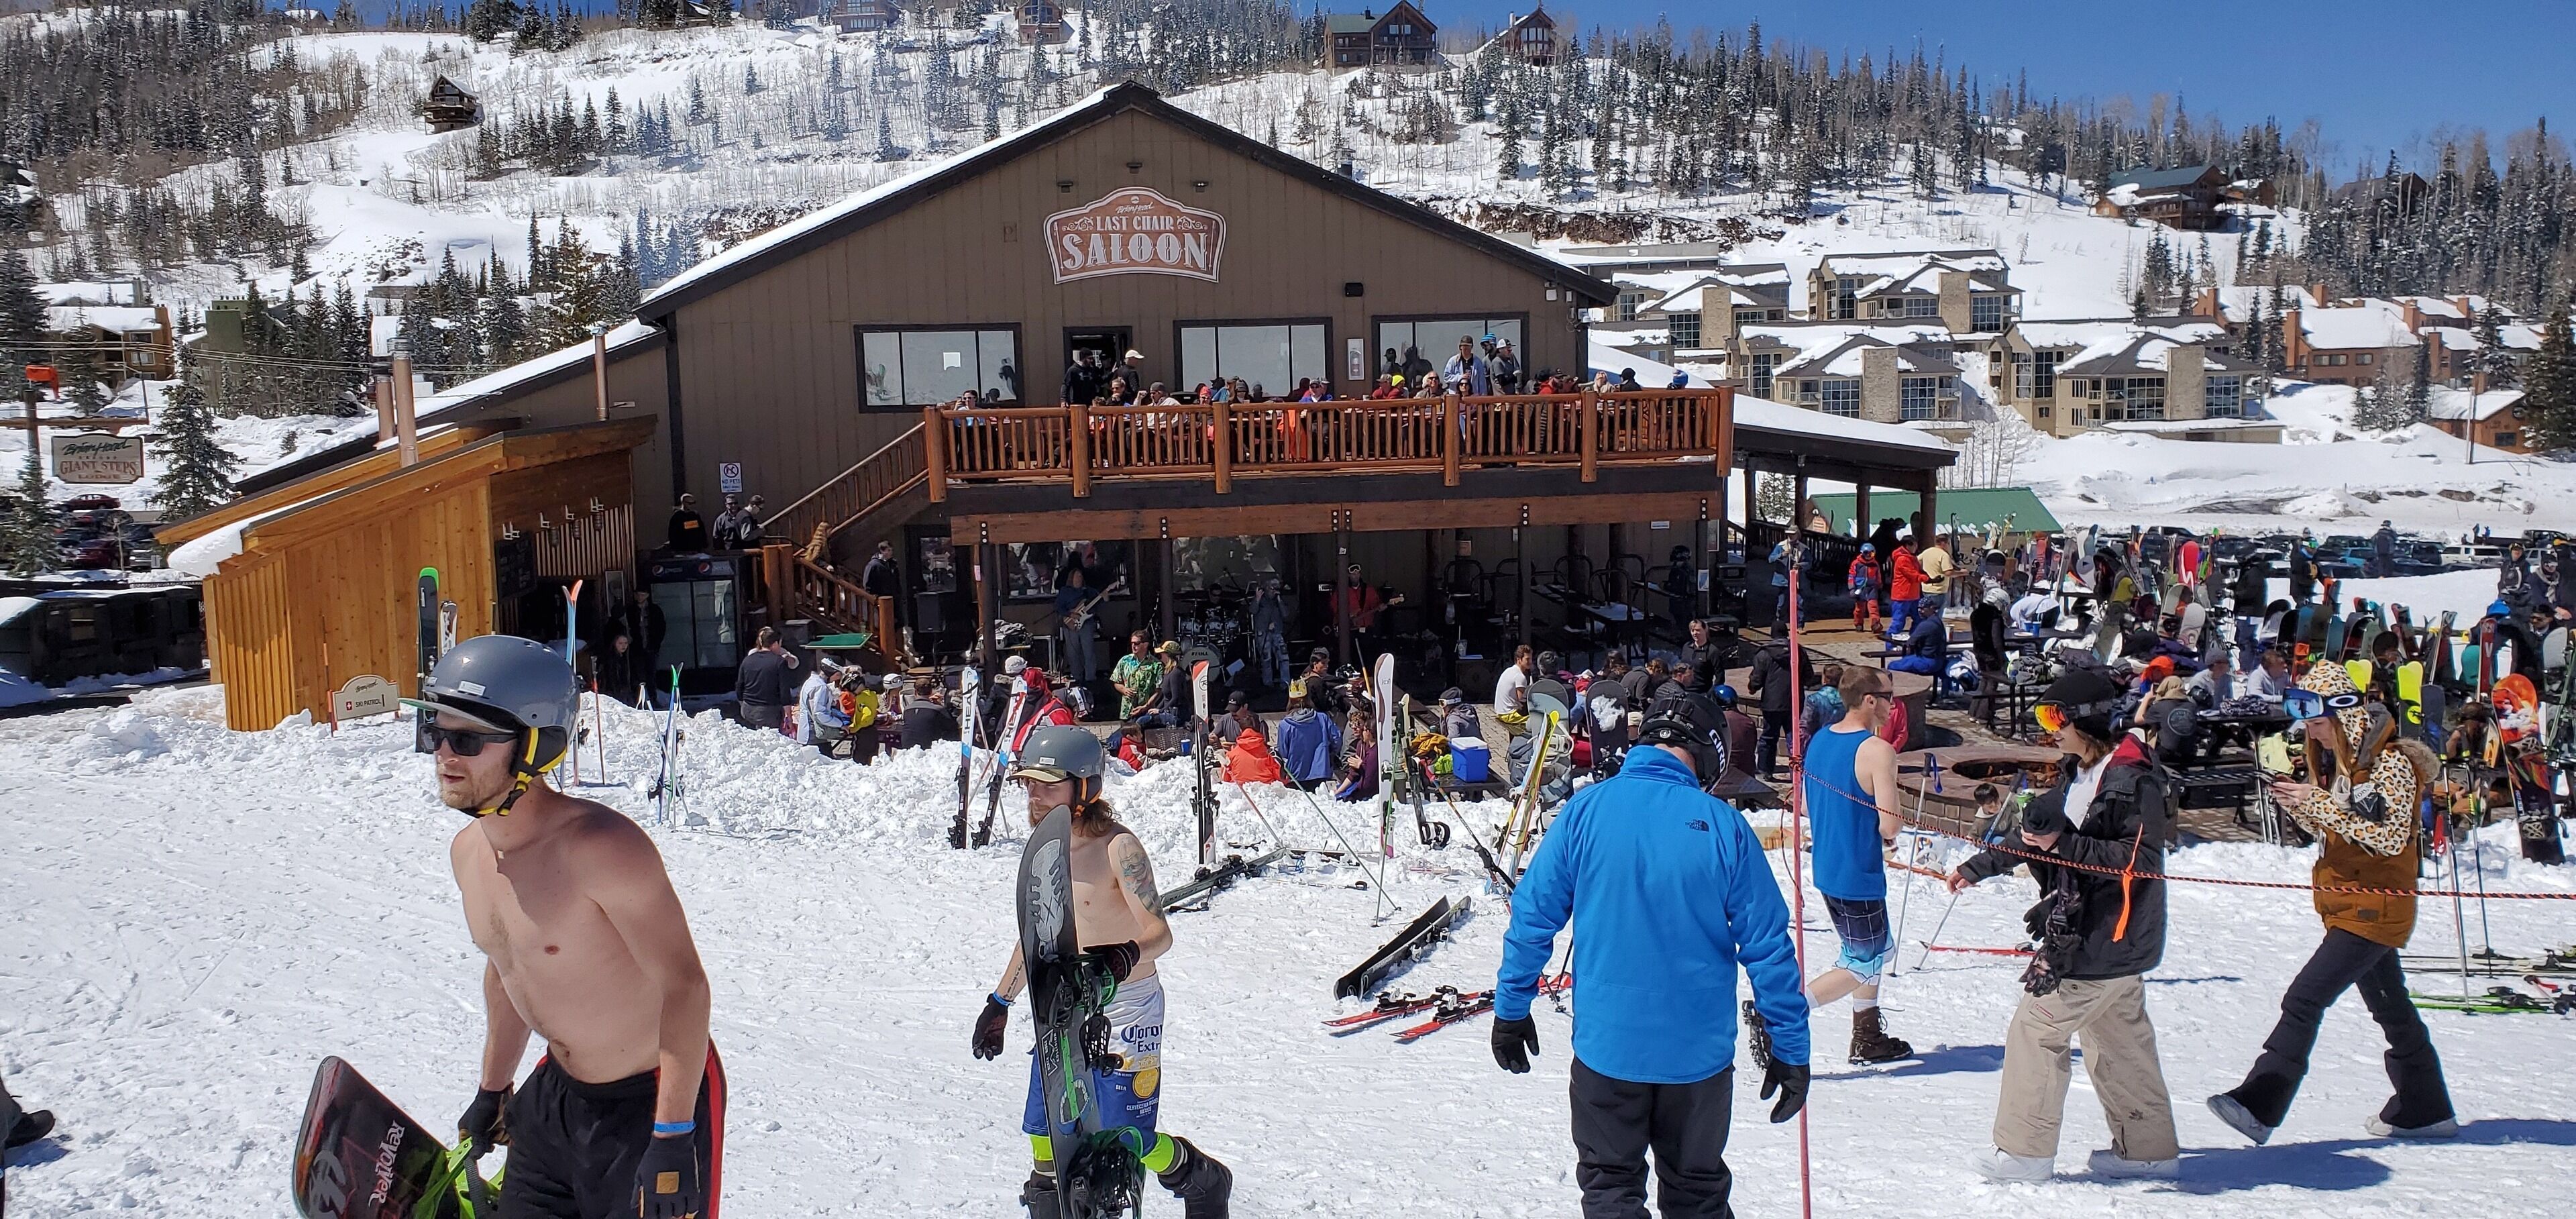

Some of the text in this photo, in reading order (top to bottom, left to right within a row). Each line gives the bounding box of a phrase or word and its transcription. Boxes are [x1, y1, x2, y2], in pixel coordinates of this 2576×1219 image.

[1096, 215, 1174, 231] LAST CHAIR
[1063, 232, 1208, 271] SALOON
[60, 460, 137, 476] GIANT STEPS
[364, 698, 382, 706] PATROL
[965, 682, 973, 731] HEAD
[1709, 729, 1725, 774] GIRO
